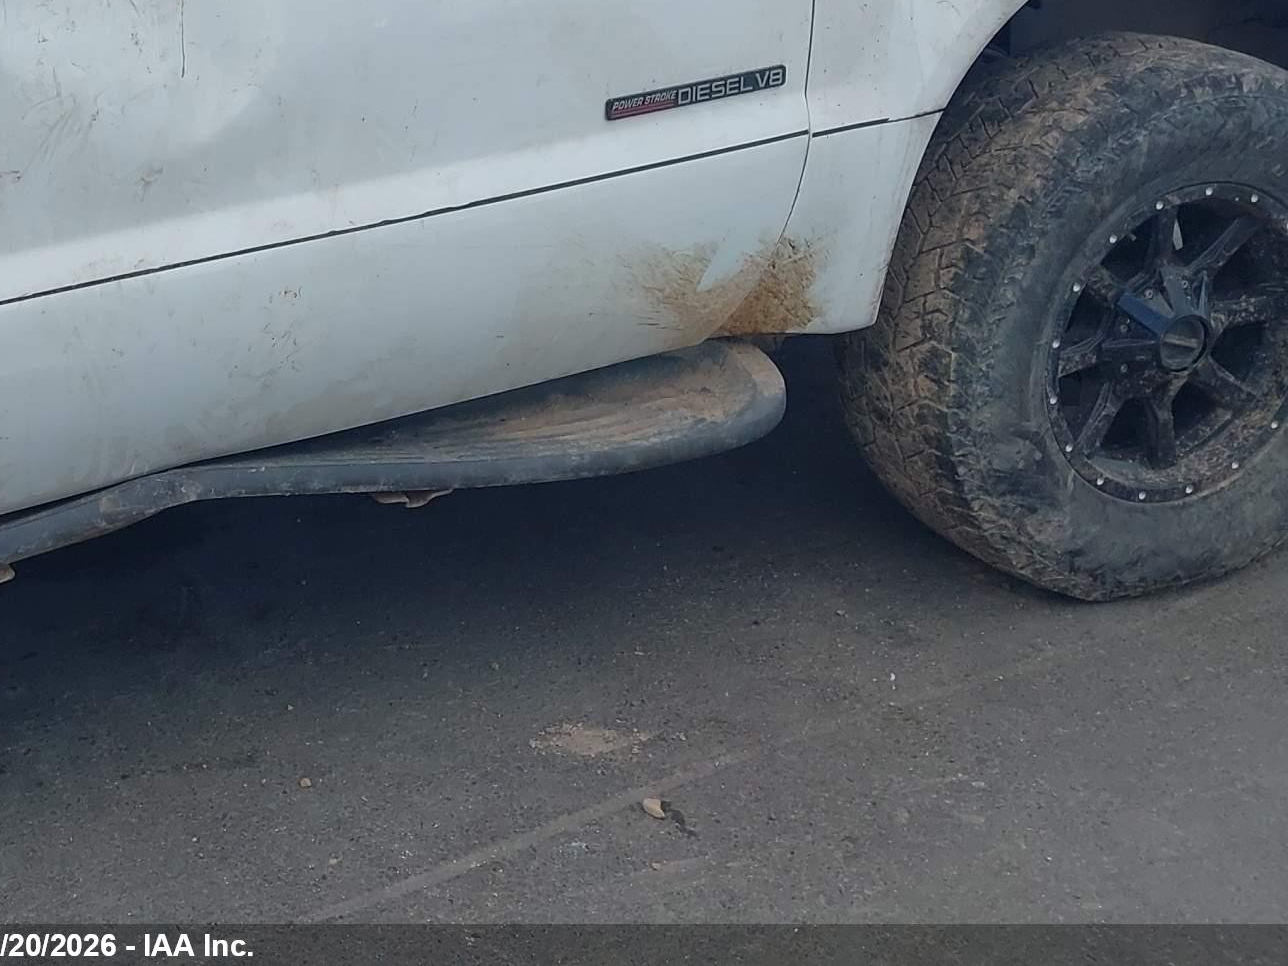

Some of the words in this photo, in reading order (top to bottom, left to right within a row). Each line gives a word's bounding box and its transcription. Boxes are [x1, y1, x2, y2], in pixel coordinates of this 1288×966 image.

[611, 96, 644, 112] POWER
[644, 90, 678, 105] STROKE
[678, 76, 753, 105] DIESEL
[755, 68, 783, 88] V8
